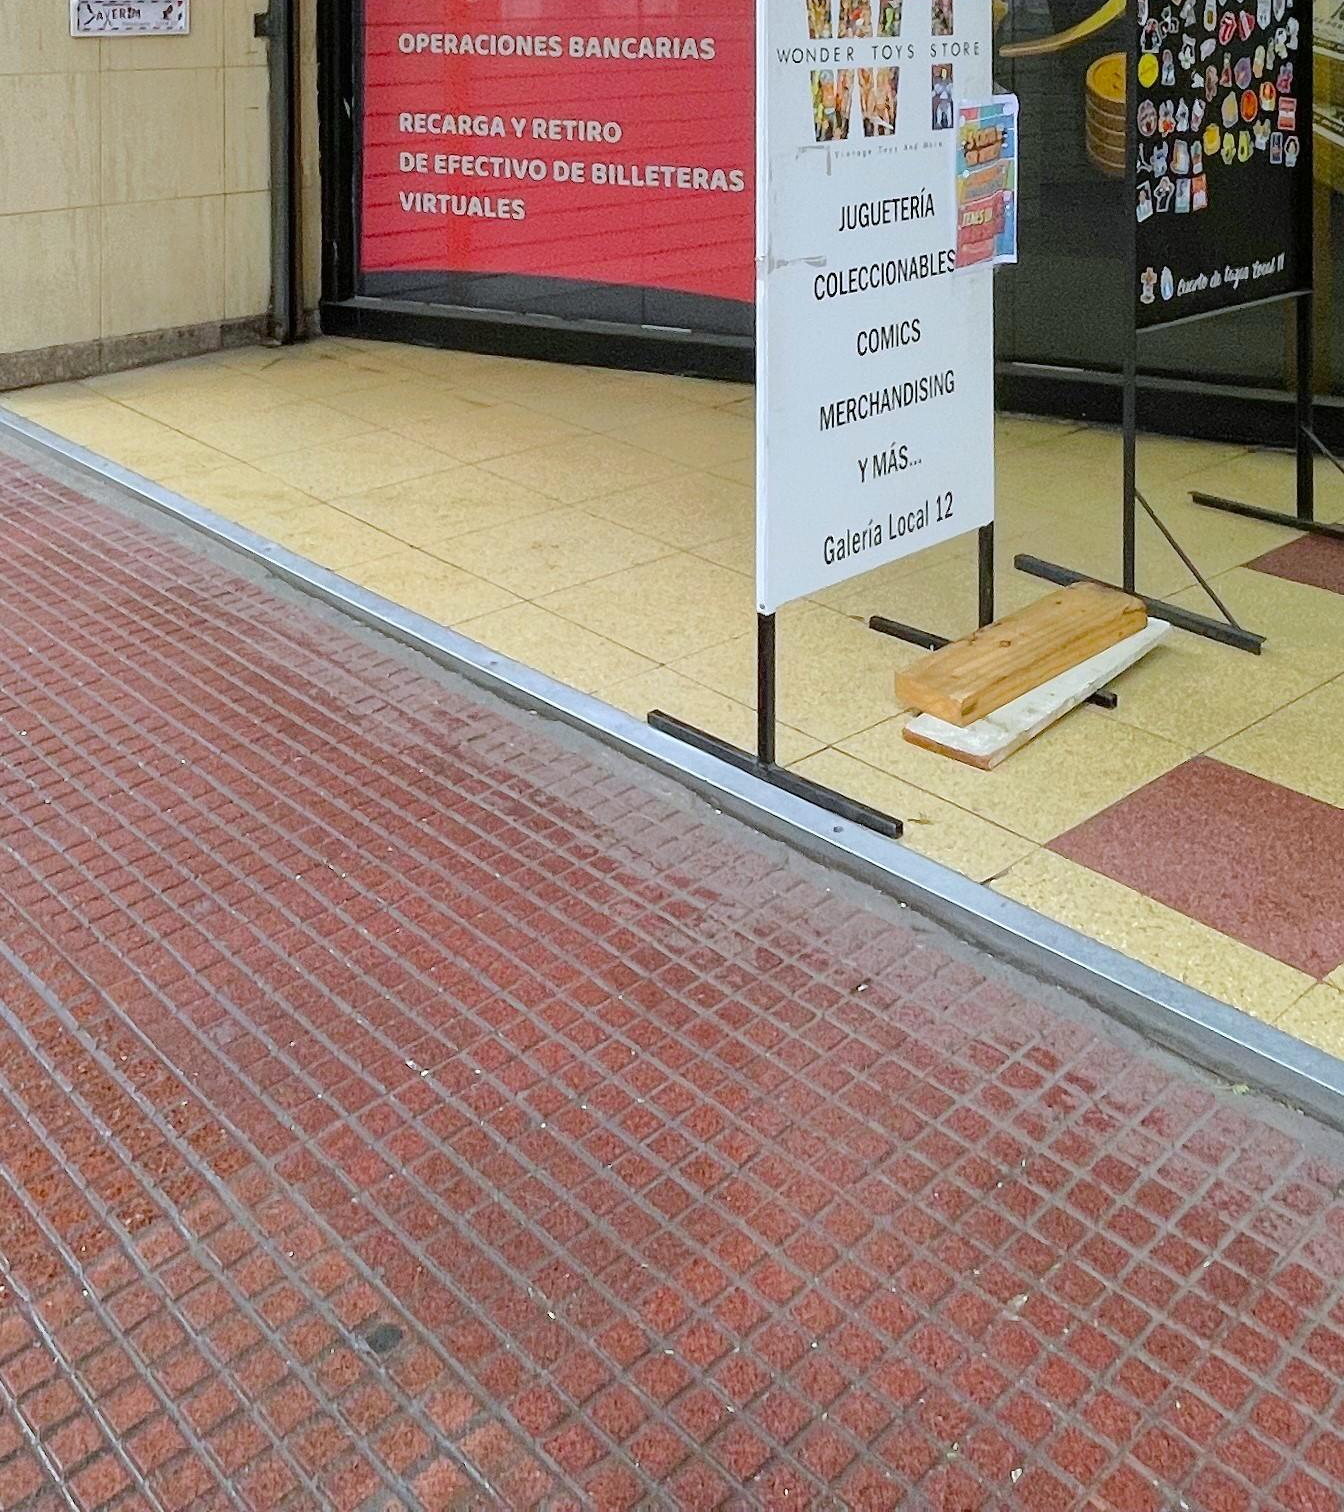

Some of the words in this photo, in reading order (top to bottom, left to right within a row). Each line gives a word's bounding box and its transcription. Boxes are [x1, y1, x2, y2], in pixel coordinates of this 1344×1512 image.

[398, 32, 563, 58] OPERACIONES
[568, 35, 716, 61] BANCARIAS
[776, 46, 855, 64] WONDER
[872, 44, 915, 61] TOYS
[930, 41, 981, 58] STORE
[399, 112, 506, 137] RECARGA
[510, 116, 527, 138] Y
[532, 117, 623, 144] RETIRO
[399, 151, 428, 173] DE
[433, 154, 547, 181] EFECTIVO
[553, 159, 585, 184] DE
[591, 163, 745, 193] BILLETERAS
[399, 190, 526, 221] VIRTUALES
[838, 187, 935, 232] JUGUETERÍA
[813, 248, 956, 301] COLECCIONABLES
[857, 318, 921, 357] COMICS
[820, 369, 955, 431] MERCHANDISING
[858, 457, 869, 483] Y
[872, 441, 922, 479] MÁS...
[823, 519, 882, 565] Galería
[889, 500, 929, 540] Local
[936, 491, 954, 522] 12
